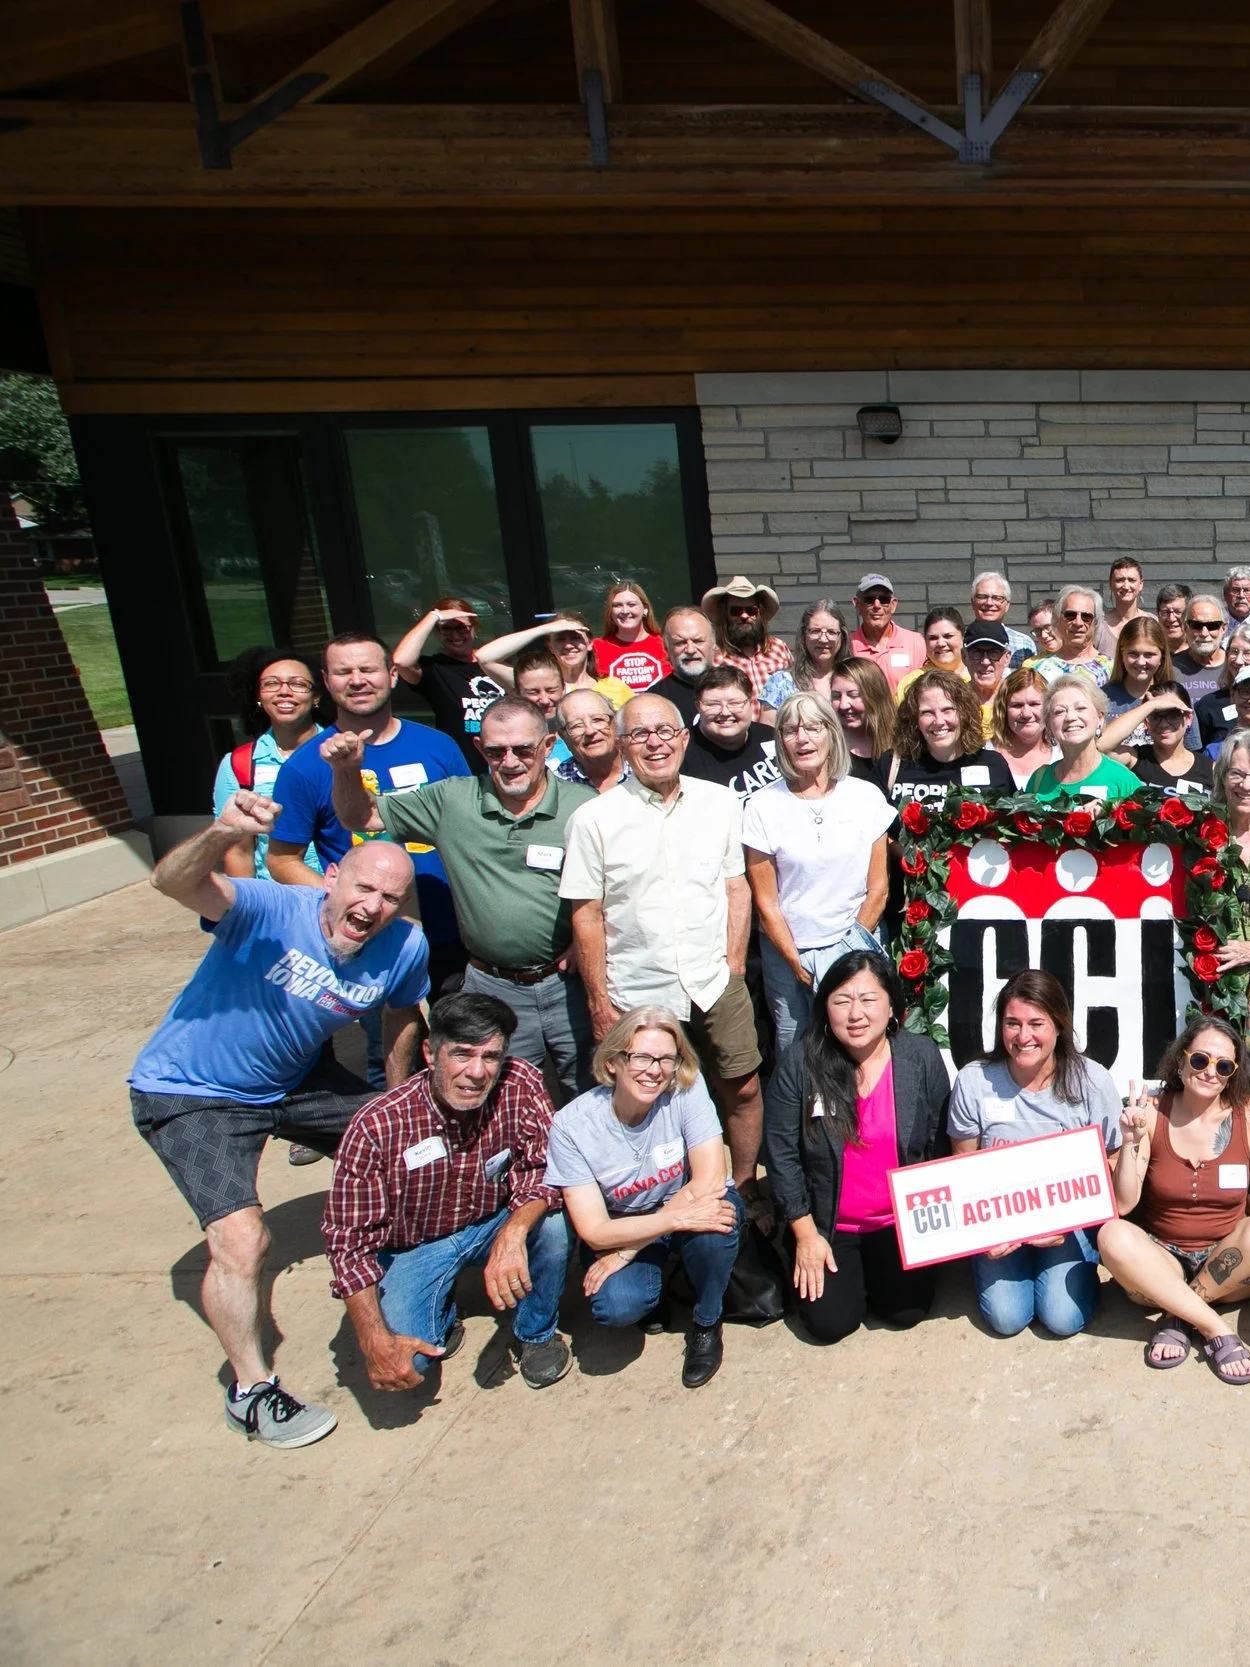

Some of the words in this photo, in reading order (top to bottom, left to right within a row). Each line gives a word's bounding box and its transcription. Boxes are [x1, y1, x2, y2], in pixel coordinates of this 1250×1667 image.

[616, 665, 655, 676] FACTORY
[624, 657, 647, 667] STOP
[621, 674, 653, 685] FARMS
[264, 963, 322, 1001] IOWA
[948, 918, 1178, 1080] CCI
[913, 1202, 951, 1235] CCI
[963, 1187, 1042, 1226] ACTION
[1045, 1174, 1101, 1206] FUND
